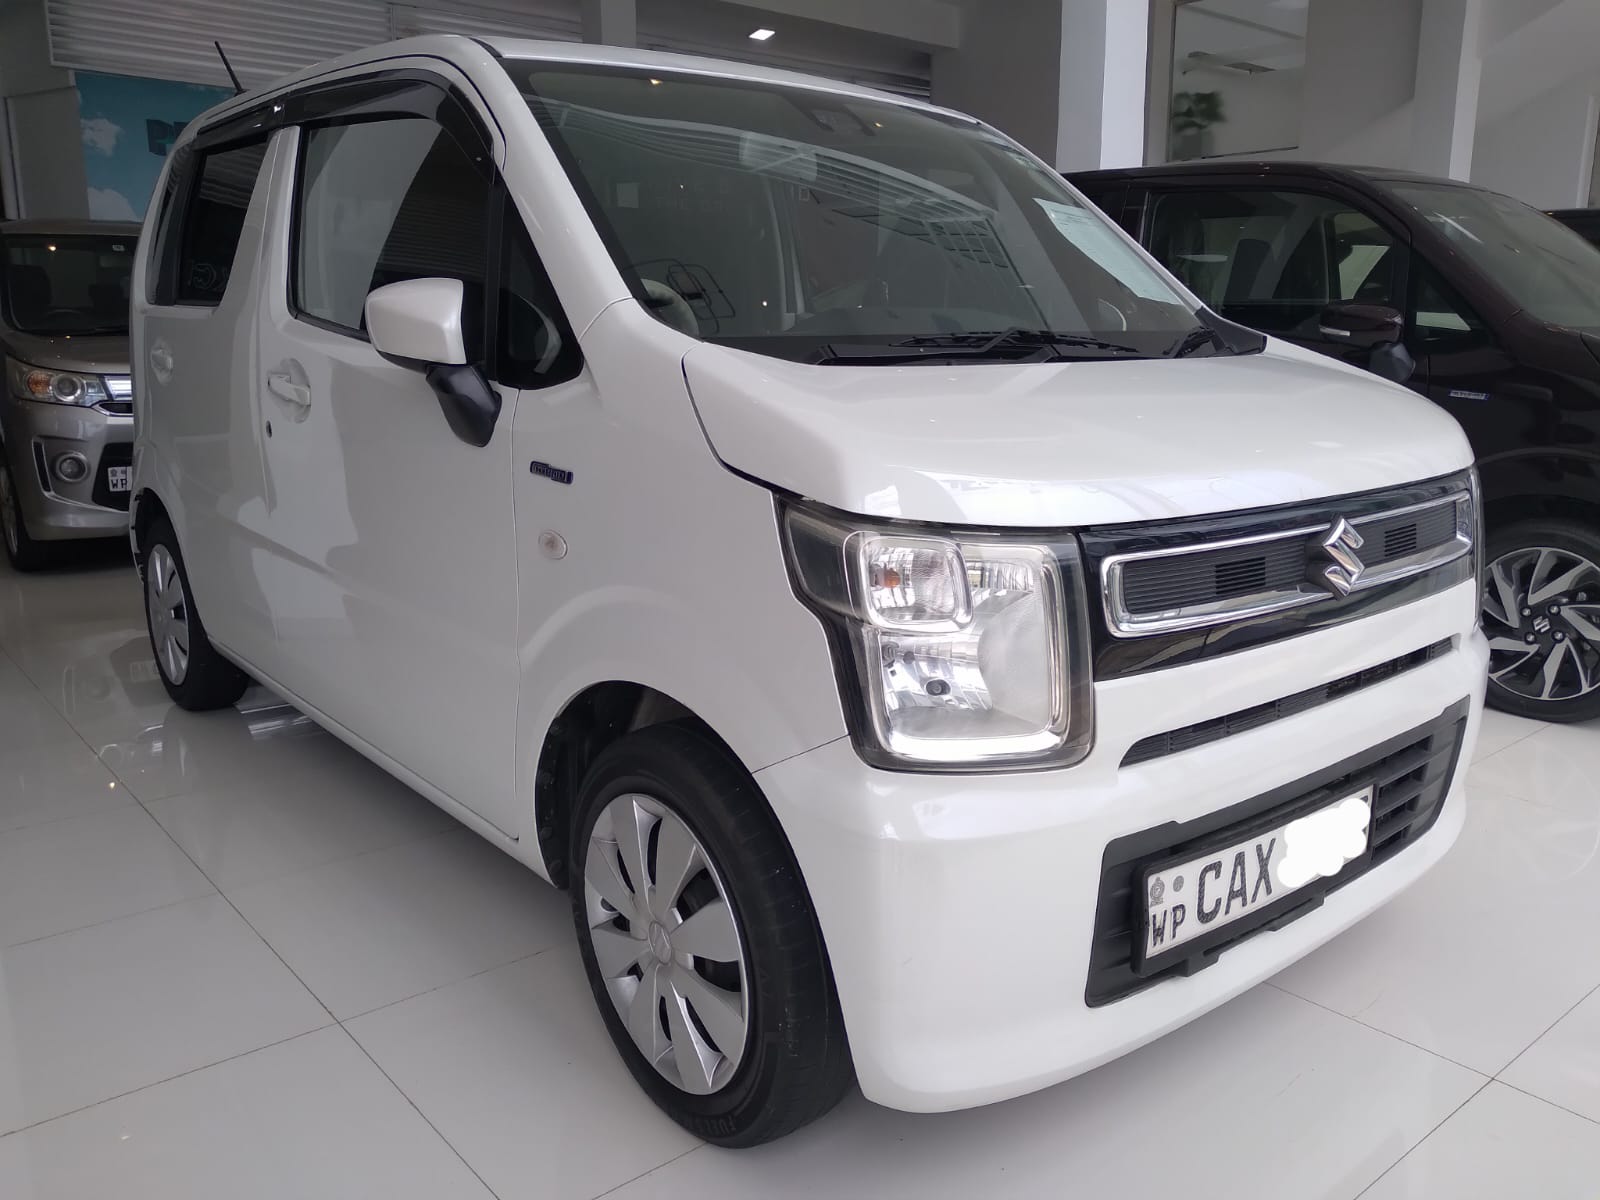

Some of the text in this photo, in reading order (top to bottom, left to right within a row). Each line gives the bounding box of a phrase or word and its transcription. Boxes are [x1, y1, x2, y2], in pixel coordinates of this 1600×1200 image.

[111, 478, 128, 489] WP
[1196, 837, 1276, 924] CAX
[1152, 904, 1186, 947] WP
